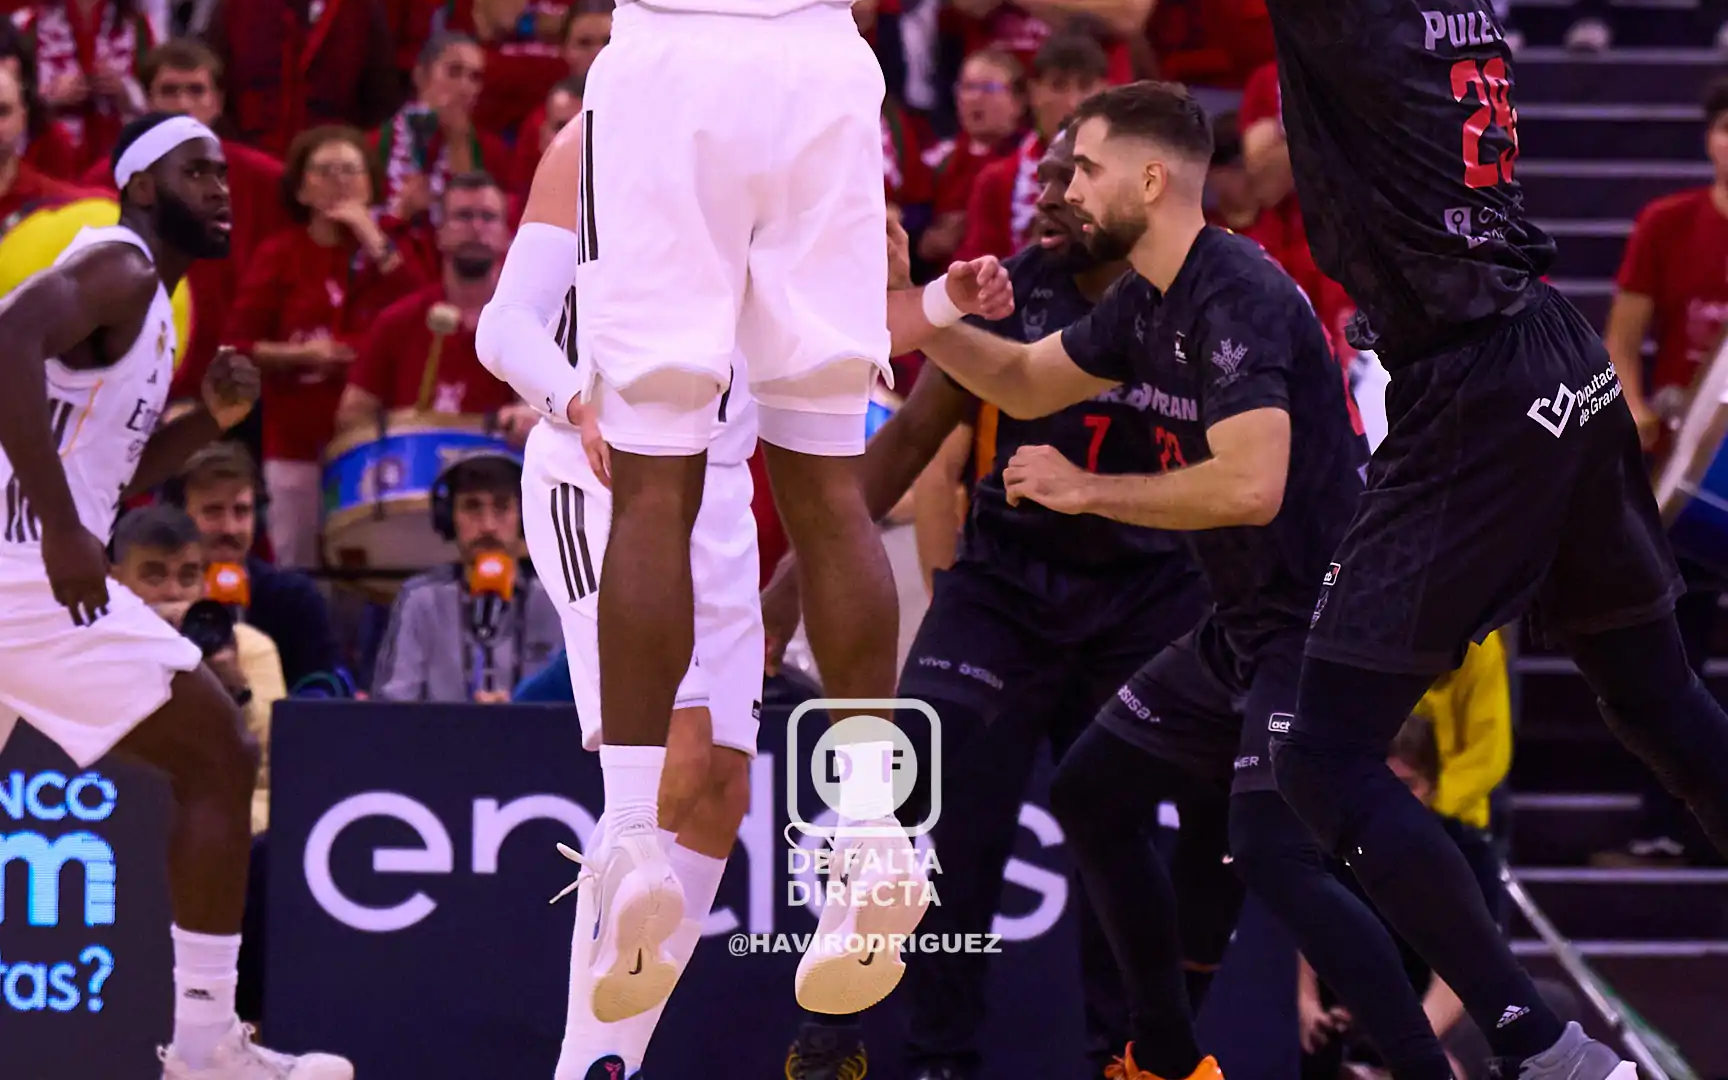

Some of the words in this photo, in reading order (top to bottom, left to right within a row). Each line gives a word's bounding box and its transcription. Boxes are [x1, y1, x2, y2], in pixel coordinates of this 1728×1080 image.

[1575, 361, 1617, 408] Diputaci
[1579, 408, 1590, 428] de
[1590, 379, 1622, 415] Grana
[1083, 414, 1111, 473] 7
